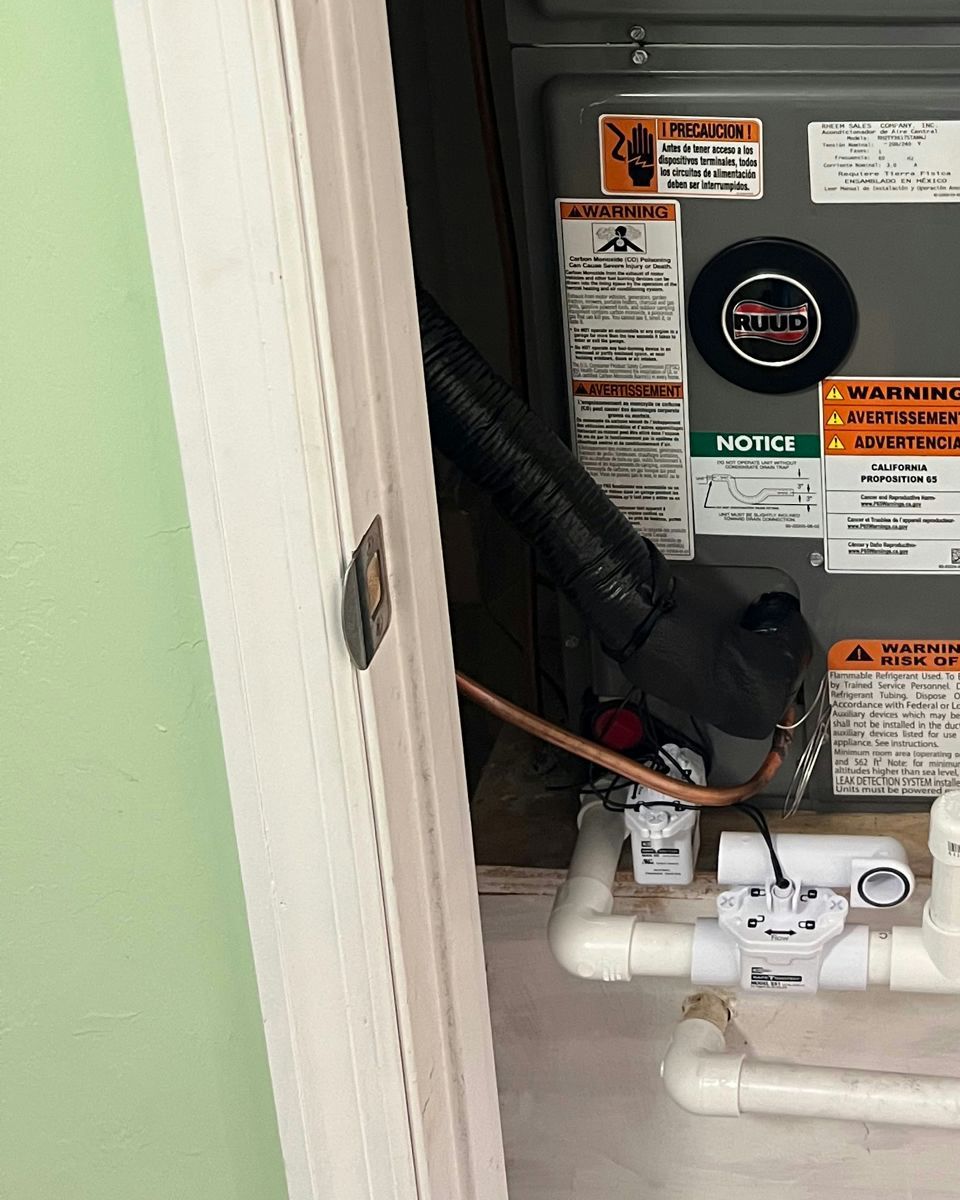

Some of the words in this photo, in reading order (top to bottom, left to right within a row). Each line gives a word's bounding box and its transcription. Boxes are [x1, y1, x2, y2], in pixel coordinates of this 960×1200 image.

[670, 122, 744, 140] PRECAUCION
[662, 143, 682, 154] Antes
[683, 144, 691, 154] de
[693, 145, 710, 154] tener
[712, 146, 736, 155] acceso
[743, 145, 754, 155] los
[658, 155, 698, 167] dispositivos
[700, 157, 738, 167] terminales,
[739, 158, 758, 167] todos
[660, 167, 671, 177] los
[672, 168, 701, 177] circuitos
[703, 168, 711, 177] de
[713, 168, 756, 179] alimentación
[667, 179, 687, 189] deben
[689, 181, 700, 189] ser
[701, 181, 750, 192] interrumpidos.
[582, 206, 668, 219] WARNING
[734, 314, 808, 332] RUUD
[589, 384, 683, 398] AVERTISSEMENT
[716, 435, 795, 452] NOTICE
[871, 464, 928, 472] CALIFORNIA
[881, 657, 926, 666] RISK
[934, 657, 958, 666] OF
[830, 672, 873, 680] Flammable
[876, 672, 918, 681] Refrigerant
[830, 681, 840, 690] by
[844, 681, 873, 689] Trained
[911, 682, 950, 690] Personnel.
[831, 691, 873, 700] Refrigerant
[916, 692, 946, 701] Dispose
[832, 700, 883, 709] Accordance
[885, 701, 904, 709] with
[836, 776, 855, 785] LEAK
[857, 777, 900, 786] DETECTION
[902, 778, 932, 787] SYSTEM
[771, 934, 789, 942] Flow
